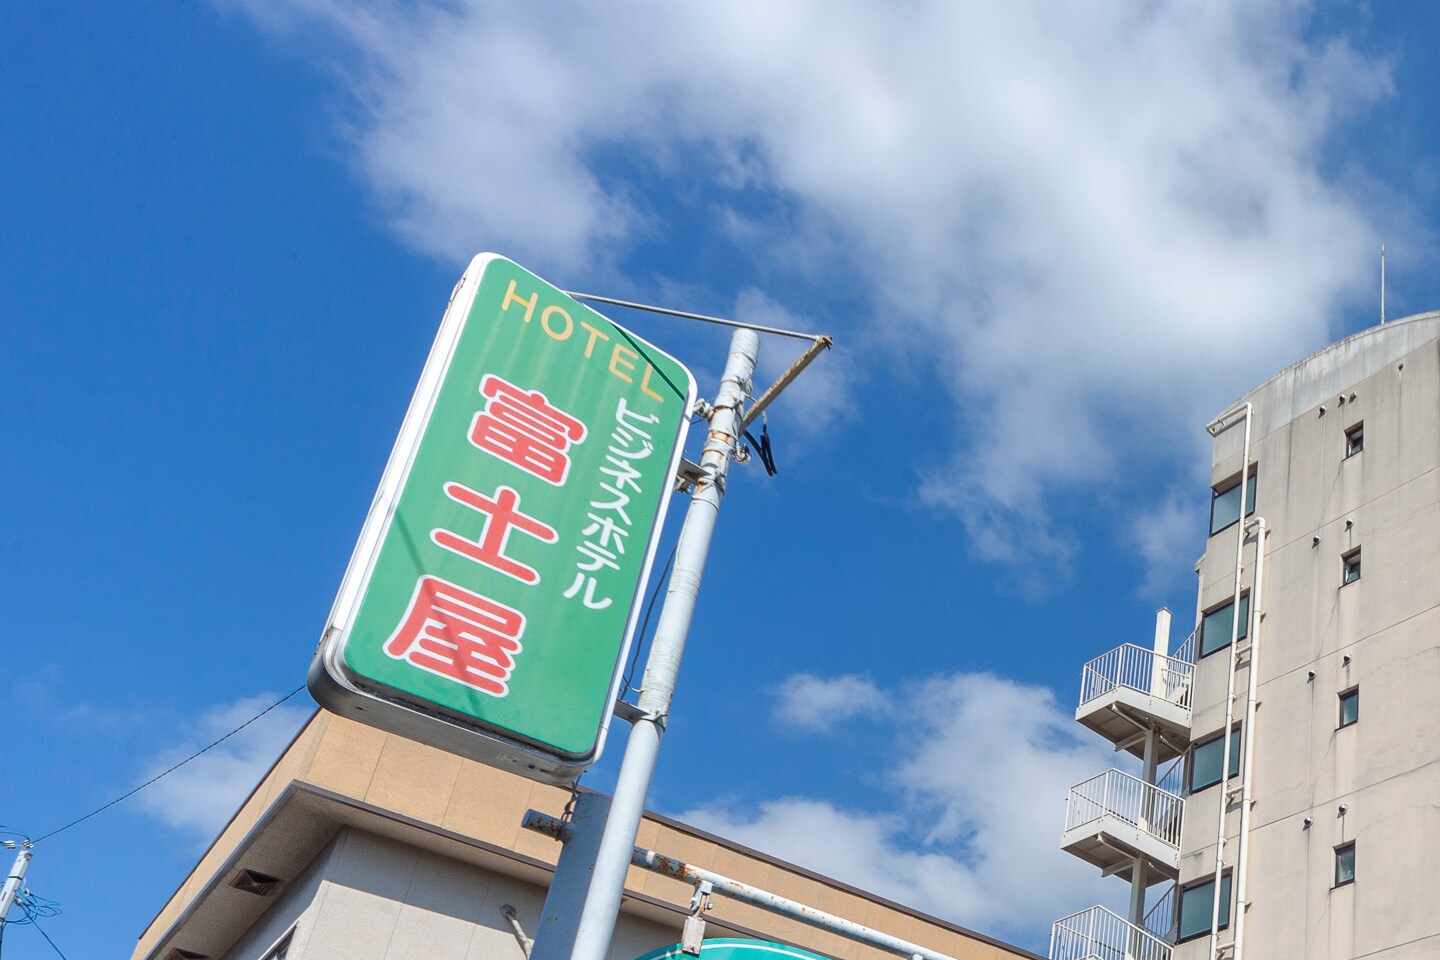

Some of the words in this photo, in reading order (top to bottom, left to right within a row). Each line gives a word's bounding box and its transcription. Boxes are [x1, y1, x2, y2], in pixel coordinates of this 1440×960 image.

[501, 279, 665, 403] HOTEL
[382, 373, 588, 698] 富士屋
[563, 397, 660, 610] ビジネスホテル
